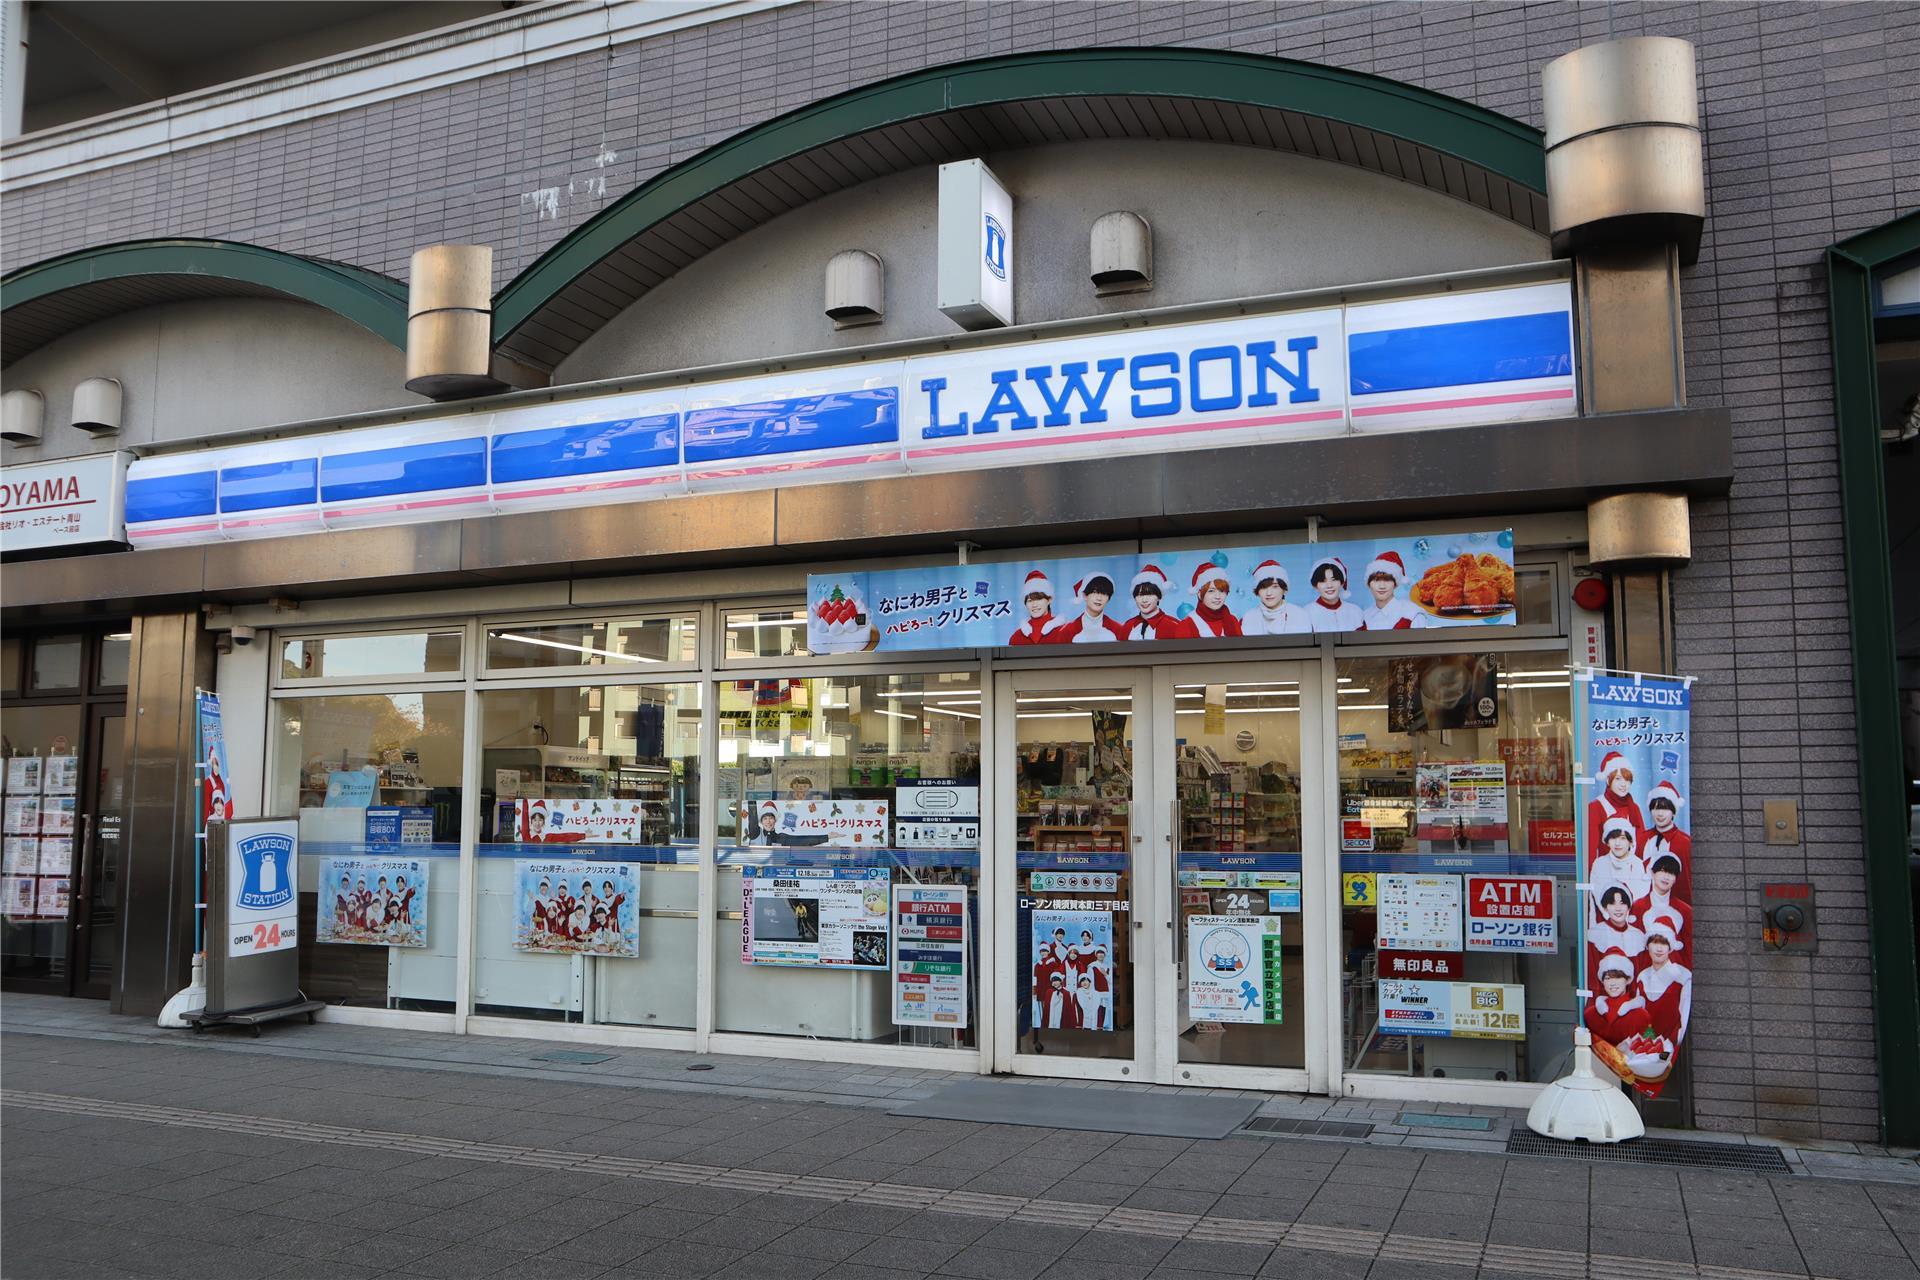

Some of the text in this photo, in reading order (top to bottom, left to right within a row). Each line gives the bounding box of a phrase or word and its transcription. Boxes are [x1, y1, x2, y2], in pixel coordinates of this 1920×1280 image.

[921, 335, 1320, 440] LAWSON
[879, 585, 968, 614] なにわ男子と
[1591, 683, 1684, 706] LAWSON
[1591, 716, 1659, 730] なにわ男子と
[243, 839, 290, 854] LAWSON
[1344, 839, 1371, 847] SECOM
[1056, 856, 1089, 864] LAWSON
[1221, 857, 1256, 865] LAWSON
[1434, 859, 1473, 867] LAWSON
[585, 866, 616, 875] クリスマス
[773, 880, 800, 888] 桑田佳祐
[243, 889, 290, 905] STATION
[1479, 882, 1541, 904] ATM
[1020, 899, 1130, 911] ローソン横須賀本町三丁目店
[1226, 893, 1250, 909] 24
[911, 903, 950, 913] 銀行ATM
[1486, 904, 1536, 916] 設置店舗
[926, 916, 953, 925] 横浜銀行
[1471, 922, 1552, 937] ローソン銀行
[234, 922, 296, 950] OPEN 24 HOURS
[924, 964, 952, 972] りそな銀行
[1393, 957, 1449, 974] 無印良品
[1401, 995, 1429, 1004] WINNER
[1476, 997, 1499, 1005] BIG
[1482, 1012, 1520, 1029] 12億
